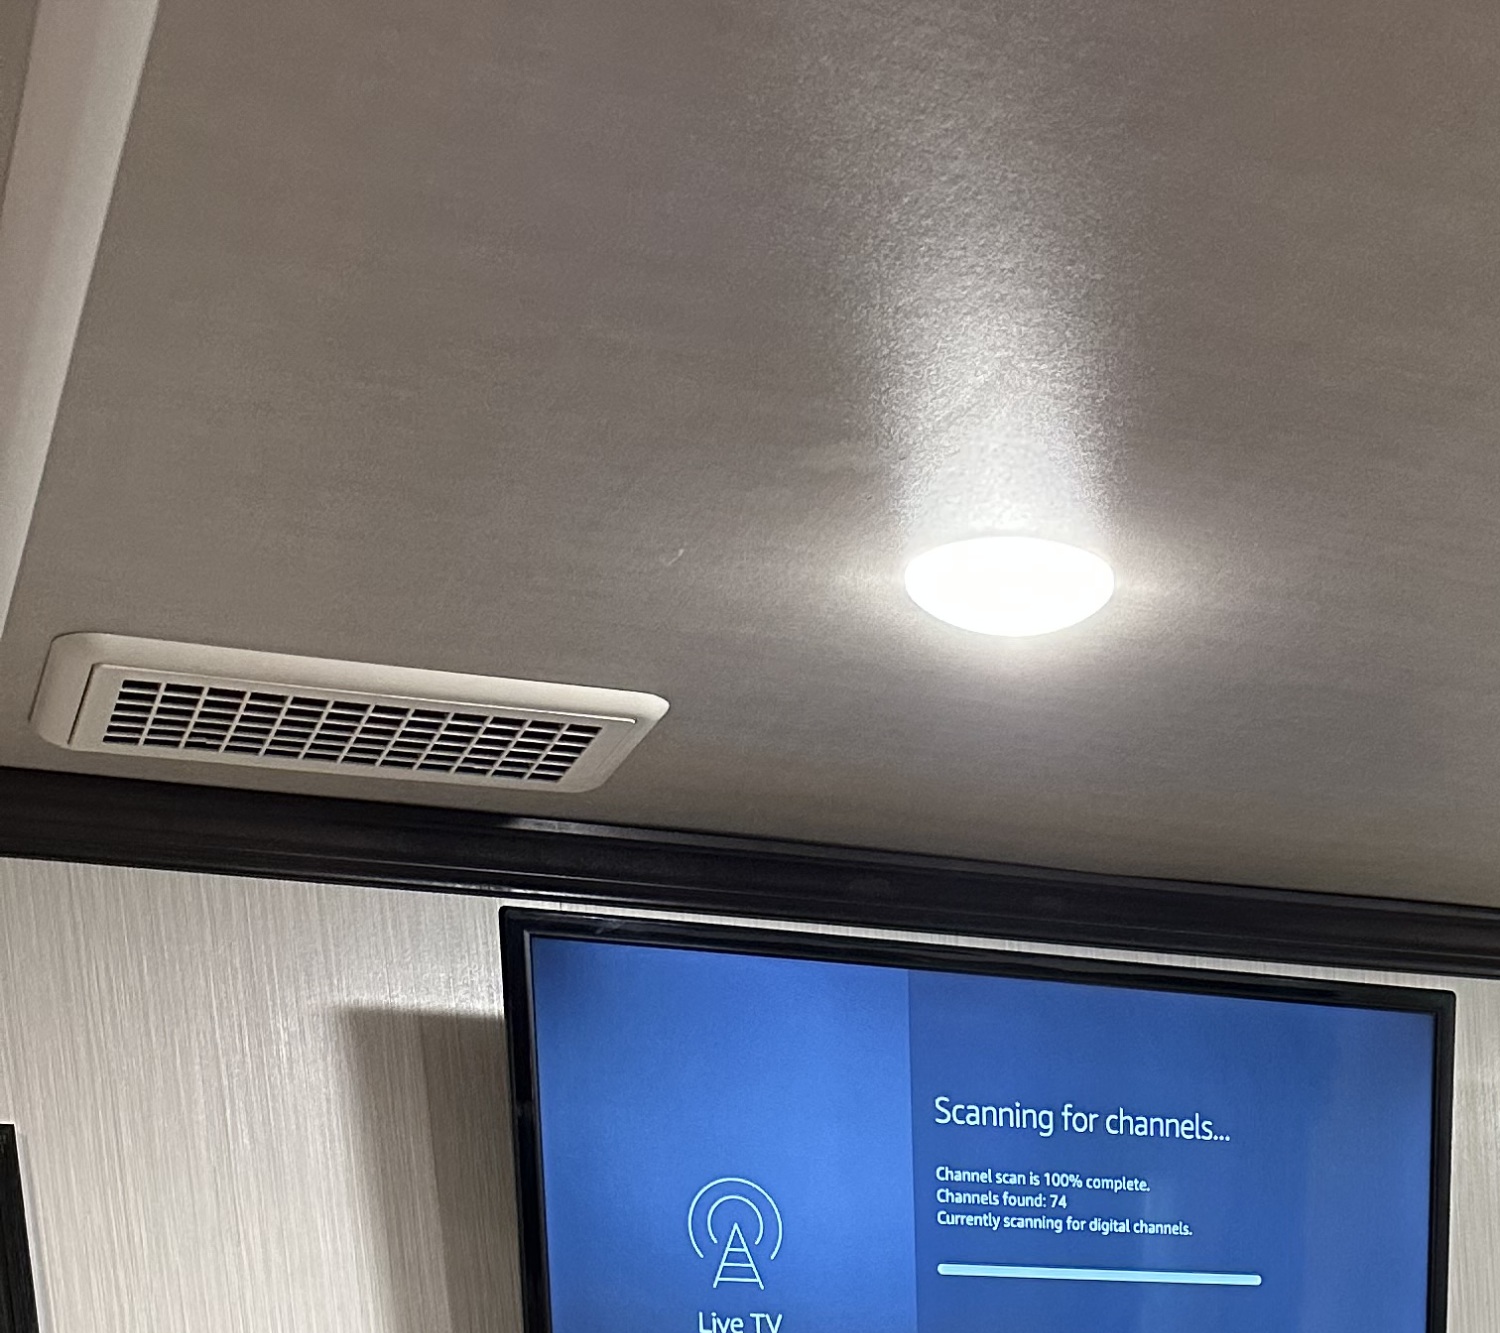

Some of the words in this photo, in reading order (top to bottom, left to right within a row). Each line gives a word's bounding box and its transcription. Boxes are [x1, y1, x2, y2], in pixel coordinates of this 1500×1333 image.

[934, 1096, 1054, 1137] Scanning
[1061, 1103, 1100, 1133] for
[1105, 1107, 1231, 1142] channels...
[935, 1166, 993, 1184] Channel
[995, 1172, 1027, 1185] scan
[1029, 1171, 1041, 1186] is
[1043, 1172, 1083, 1189] 100%
[1085, 1175, 1151, 1193] complete.
[936, 1188, 1000, 1206] Channels
[1002, 1190, 1047, 1208] found:
[1049, 1194, 1068, 1209] 74
[937, 1210, 1001, 1231] Currently
[1003, 1215, 1063, 1234] scanning
[1065, 1215, 1087, 1231] for
[1088, 1217, 1131, 1236] digital
[1133, 1219, 1193, 1236] channels.
